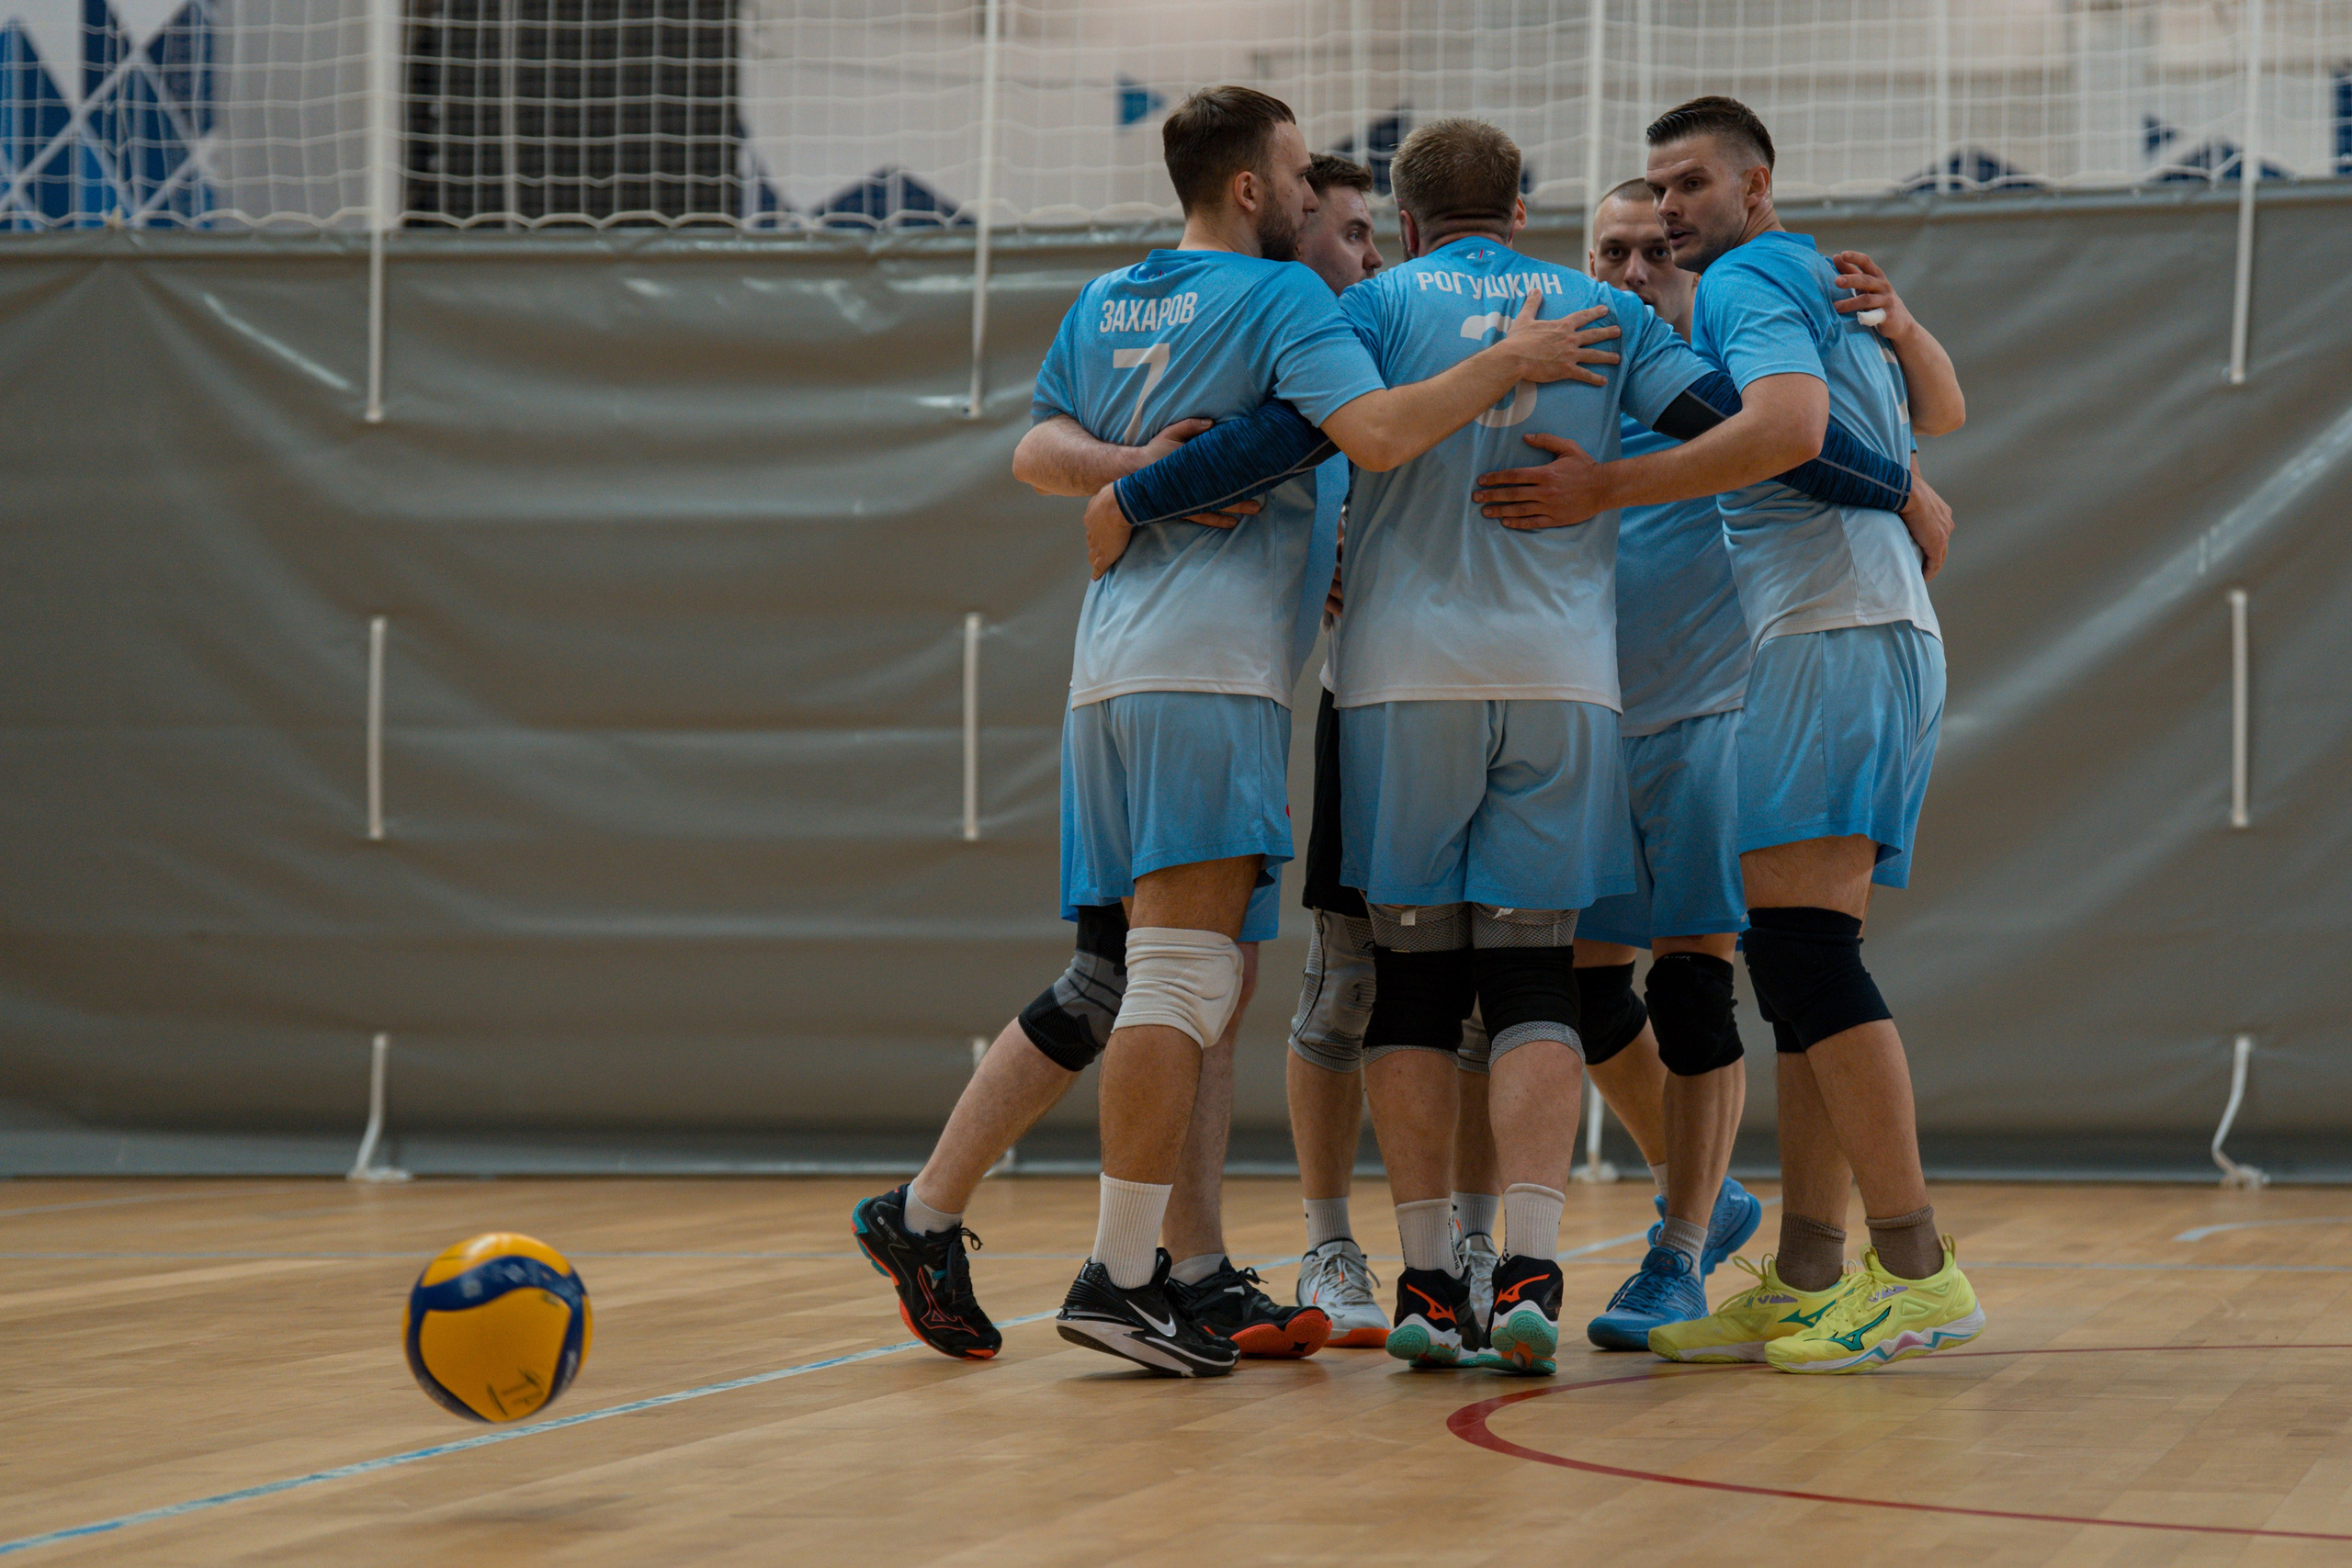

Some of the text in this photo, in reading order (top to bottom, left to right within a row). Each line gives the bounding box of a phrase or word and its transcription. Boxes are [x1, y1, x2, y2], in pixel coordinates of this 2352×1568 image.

[1416, 270, 1564, 300] РОГУШКИН
[1099, 291, 1199, 333] ЗАХАРОВ
[1113, 343, 1170, 447] 7
